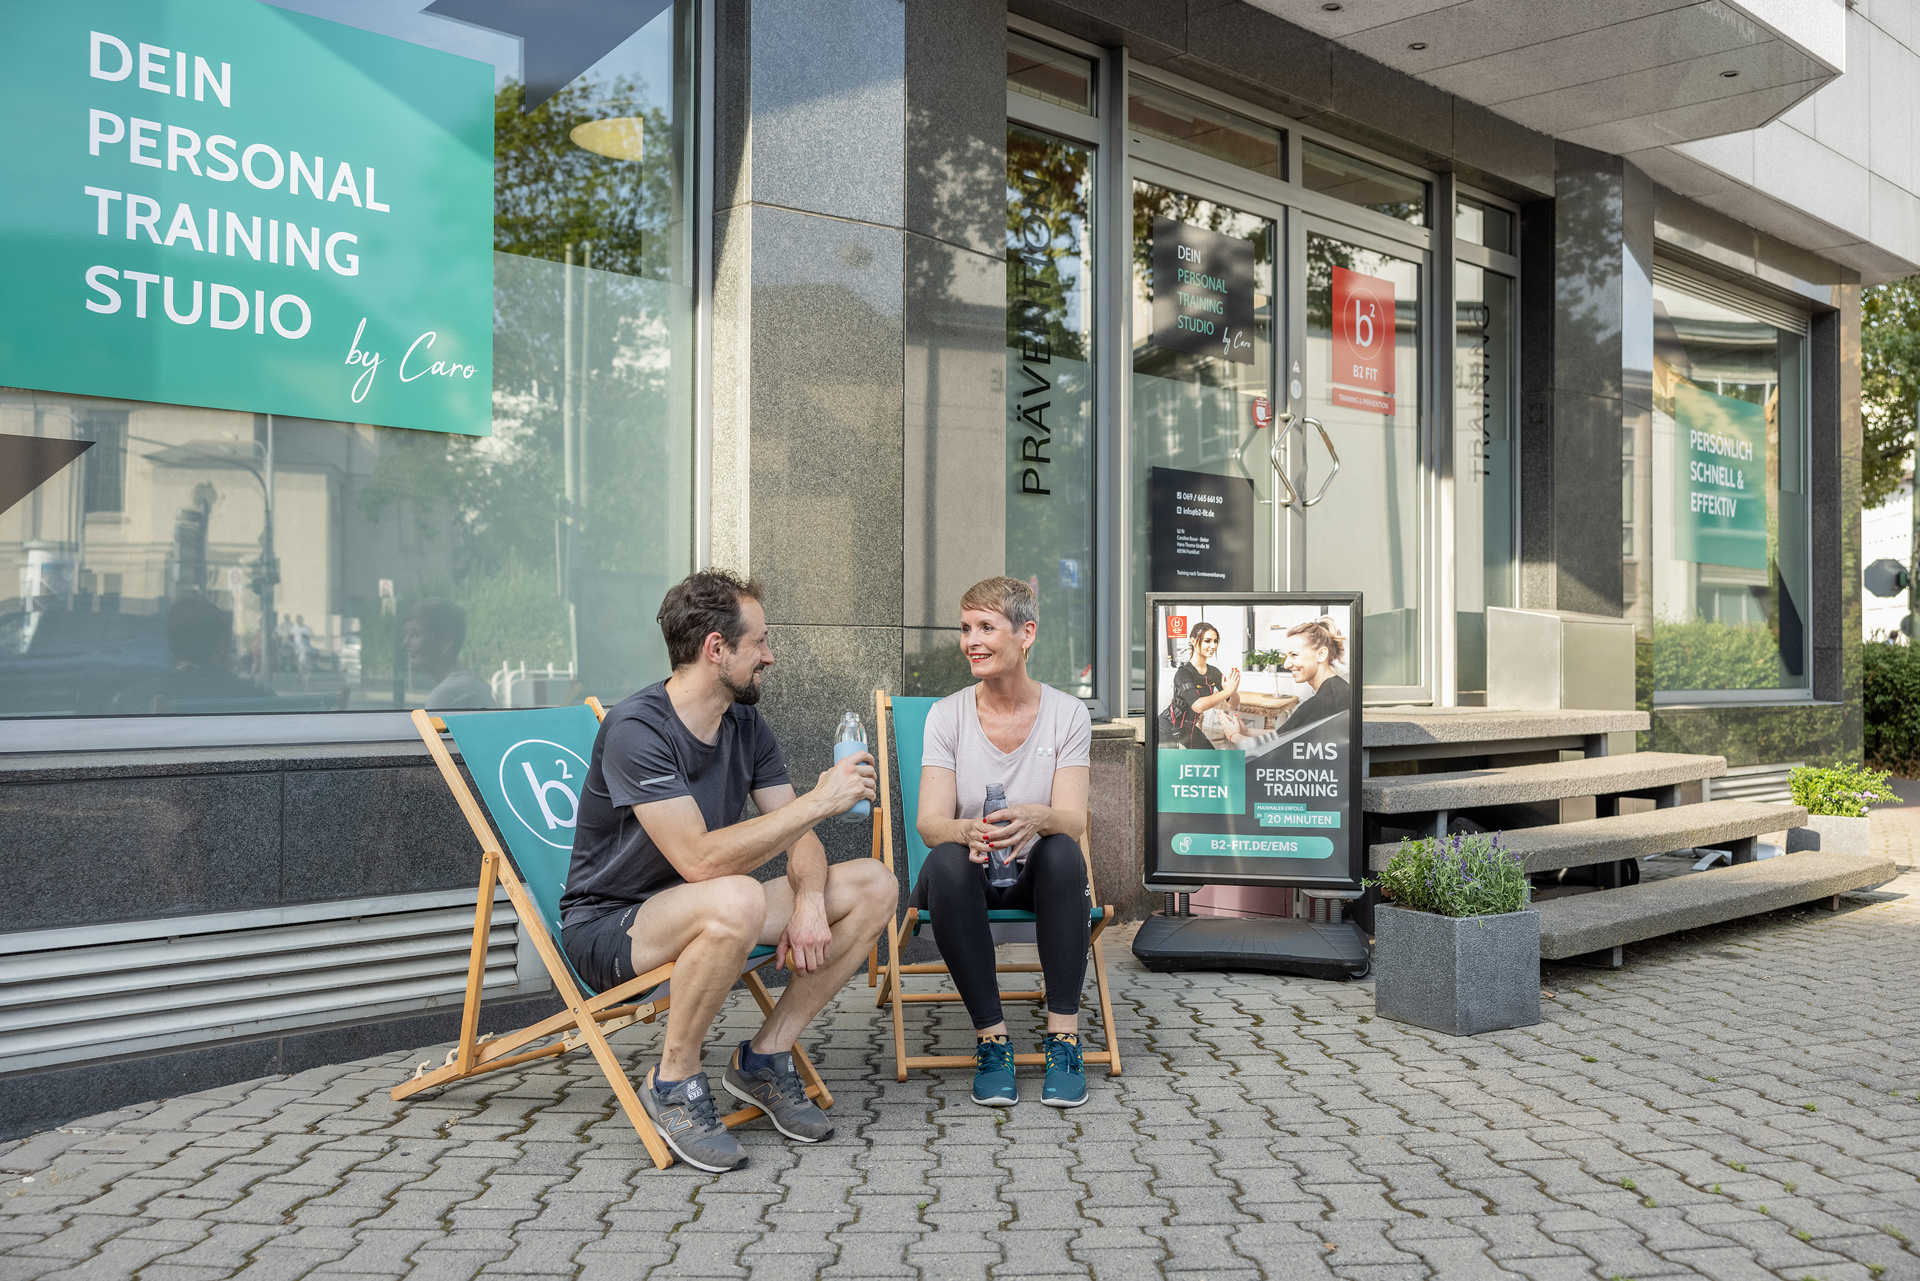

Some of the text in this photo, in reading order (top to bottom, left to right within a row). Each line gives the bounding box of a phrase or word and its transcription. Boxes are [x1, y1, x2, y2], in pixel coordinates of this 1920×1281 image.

[89, 30, 232, 108] DEIN
[89, 108, 391, 213] PERSONAL
[84, 185, 360, 277] TRAINING
[1177, 245, 1201, 264] DEIN
[1177, 268, 1228, 294] PERSONAL
[85, 265, 312, 340] STUDIO
[1177, 291, 1224, 315] TRAINING
[1016, 174, 1051, 496] PRÄVENTION
[1177, 314, 1215, 336] STUDIO
[1222, 326, 1251, 355] by Caro
[344, 317, 478, 403] by Caro
[1353, 364, 1378, 381] B2 FIT
[1338, 393, 1359, 404] TRAINING
[1362, 398, 1389, 409] PRÄVENTION
[1690, 429, 1753, 462] PERSÖNLICH
[1690, 460, 1744, 490] SCHNELL &
[1183, 493, 1193, 501] 069
[1193, 494, 1197, 502] /
[1197, 494, 1207, 503] 665
[1690, 491, 1737, 518] EFFEKTIV
[1183, 507, 1215, 518] info@b2-fit.de
[1177, 569, 1188, 577] Training
[1292, 742, 1338, 761] EMS
[1179, 764, 1220, 780] JETZT
[1256, 768, 1339, 783] PERSONAL
[1171, 784, 1228, 799] TESTEN
[1263, 783, 1338, 797] TRAINING
[1267, 814, 1281, 824] 20
[1283, 815, 1332, 825] MINUTEN
[1210, 839, 1298, 852] B2-FIT.DE/EMS
